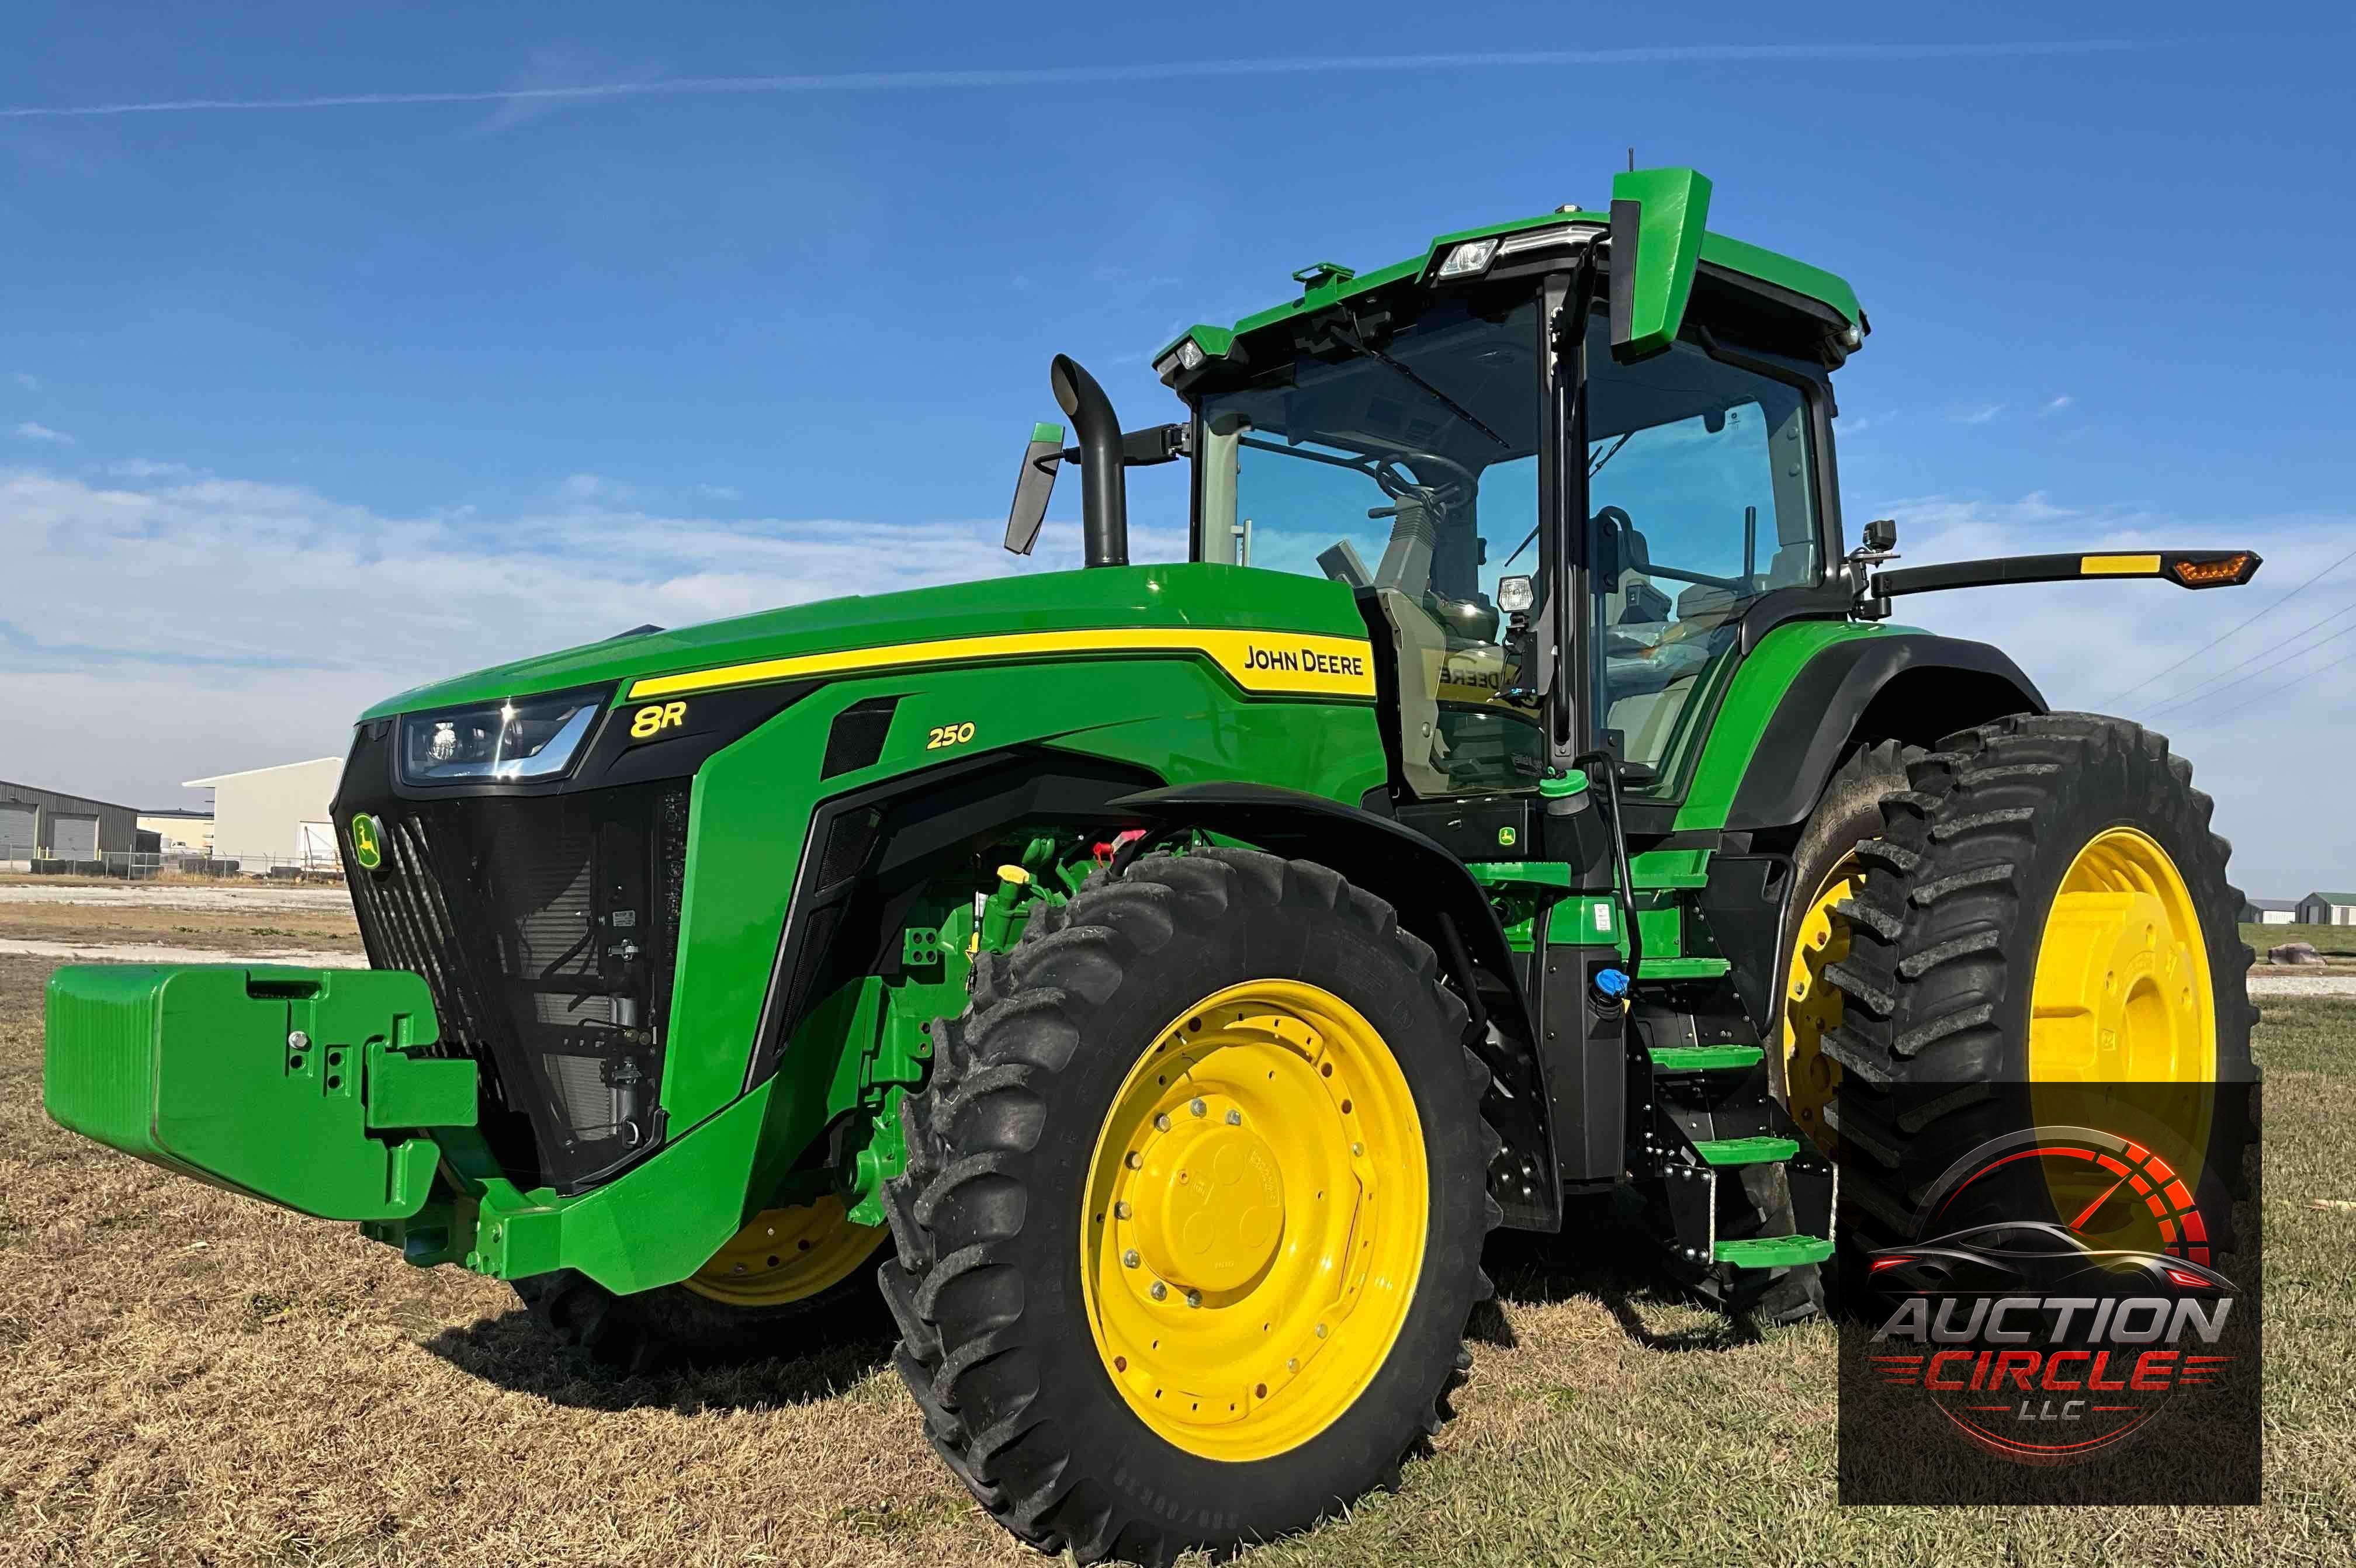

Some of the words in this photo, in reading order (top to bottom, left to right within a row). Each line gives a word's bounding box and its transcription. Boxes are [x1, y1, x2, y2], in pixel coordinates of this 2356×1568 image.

[1244, 646, 1298, 671] JOHN
[1301, 648, 1364, 676] DEERE
[630, 701, 687, 738] 8R
[926, 721, 976, 750] 250
